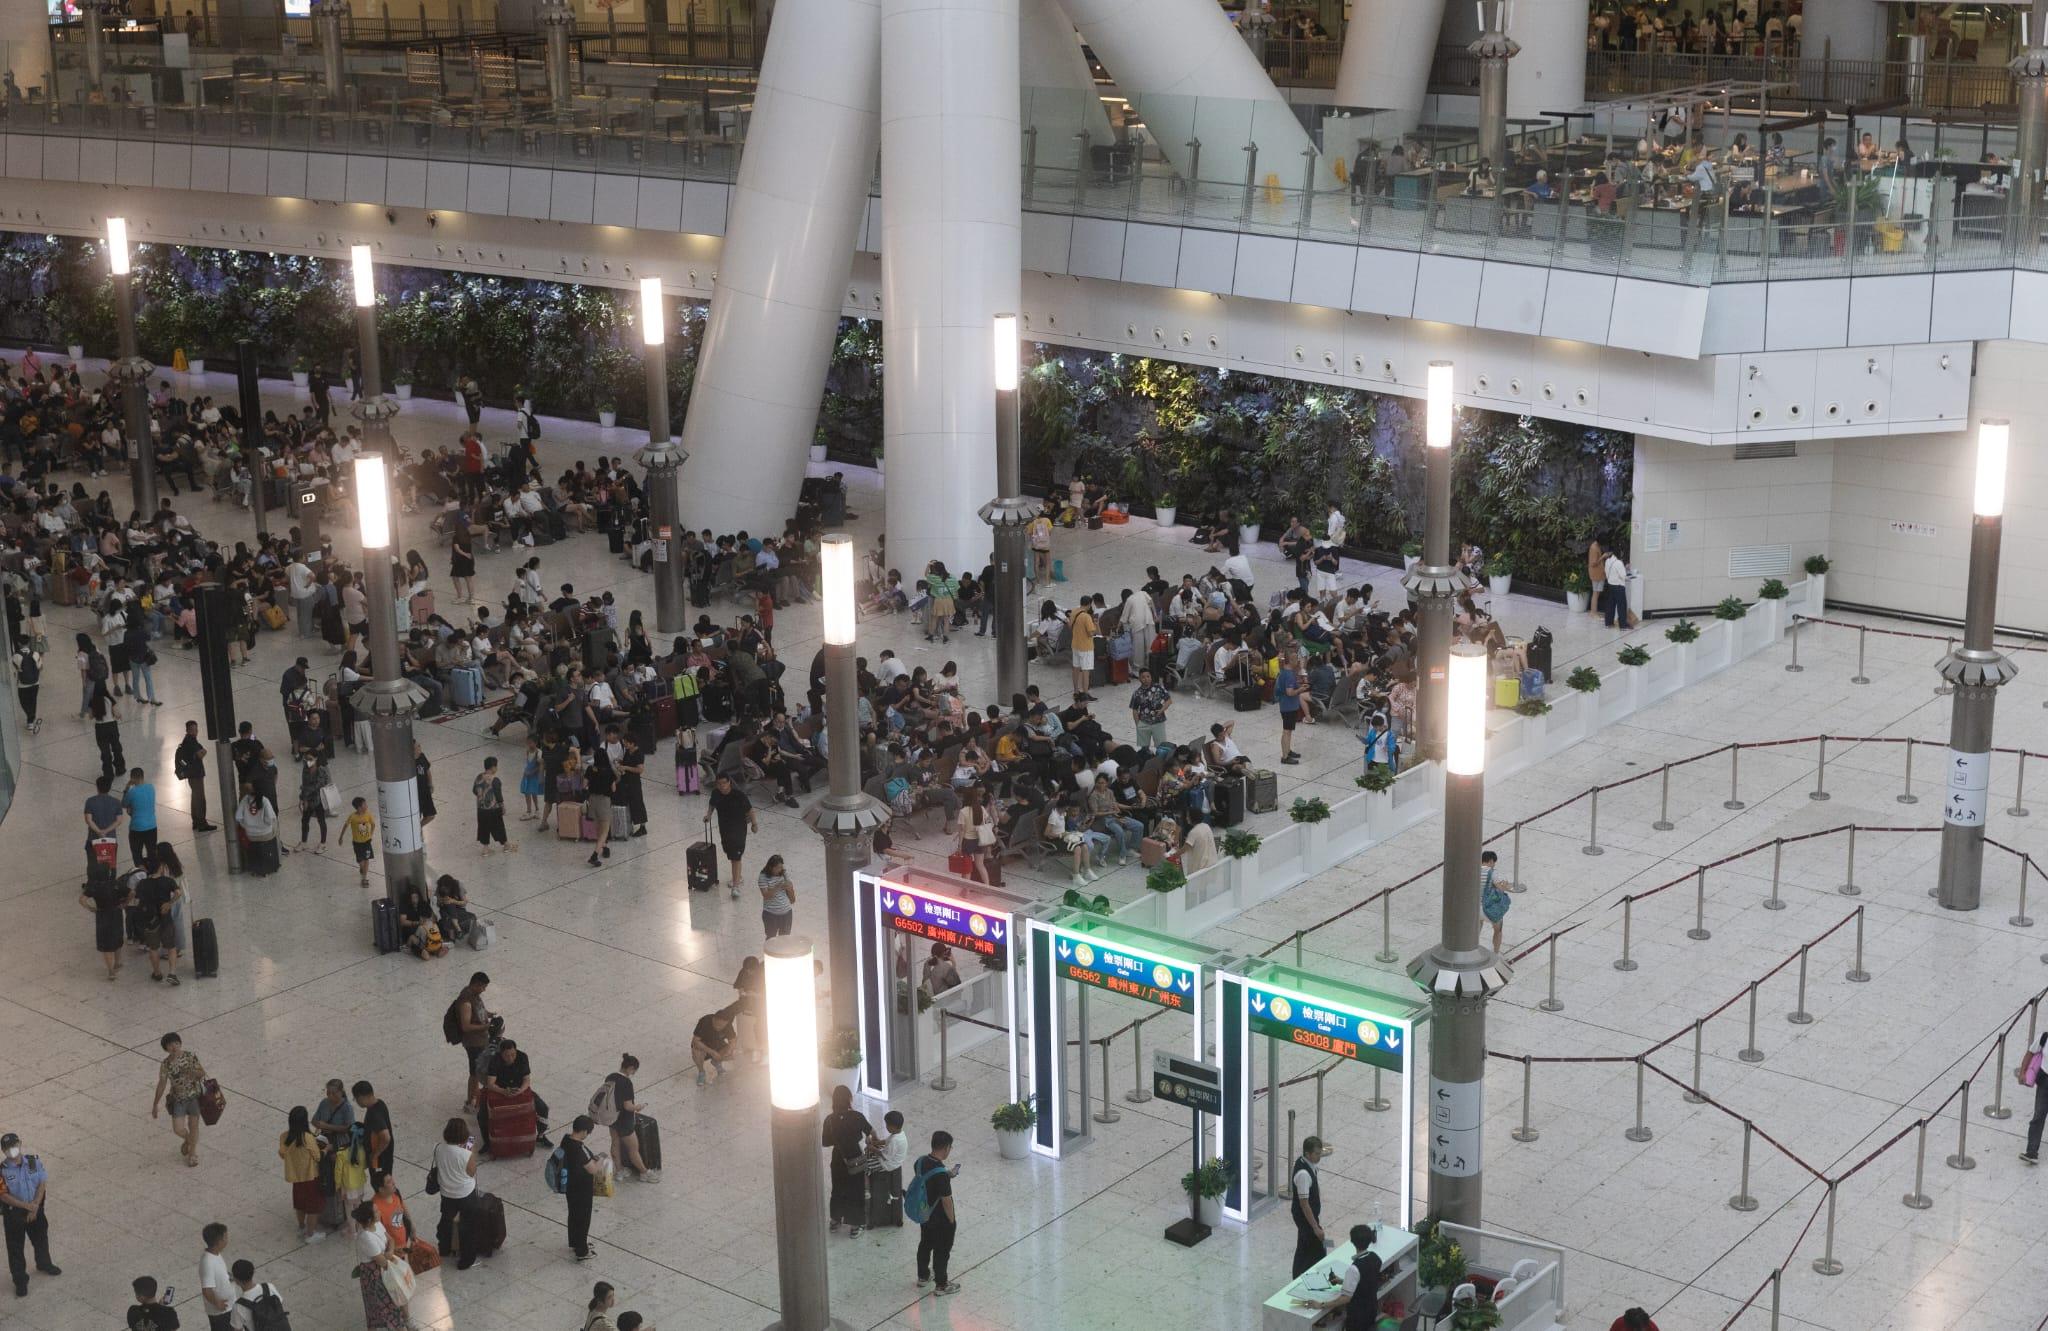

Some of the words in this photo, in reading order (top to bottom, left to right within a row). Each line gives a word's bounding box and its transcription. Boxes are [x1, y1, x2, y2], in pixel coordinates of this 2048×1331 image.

[895, 916, 924, 934] G6502
[965, 936, 994, 954] 广州南
[1069, 966, 1100, 984] G6562
[1148, 987, 1182, 1007] 广州东
[1274, 1001, 1288, 1017] 7A
[1293, 1028, 1330, 1049] G3008
[1361, 1024, 1377, 1040] 8A
